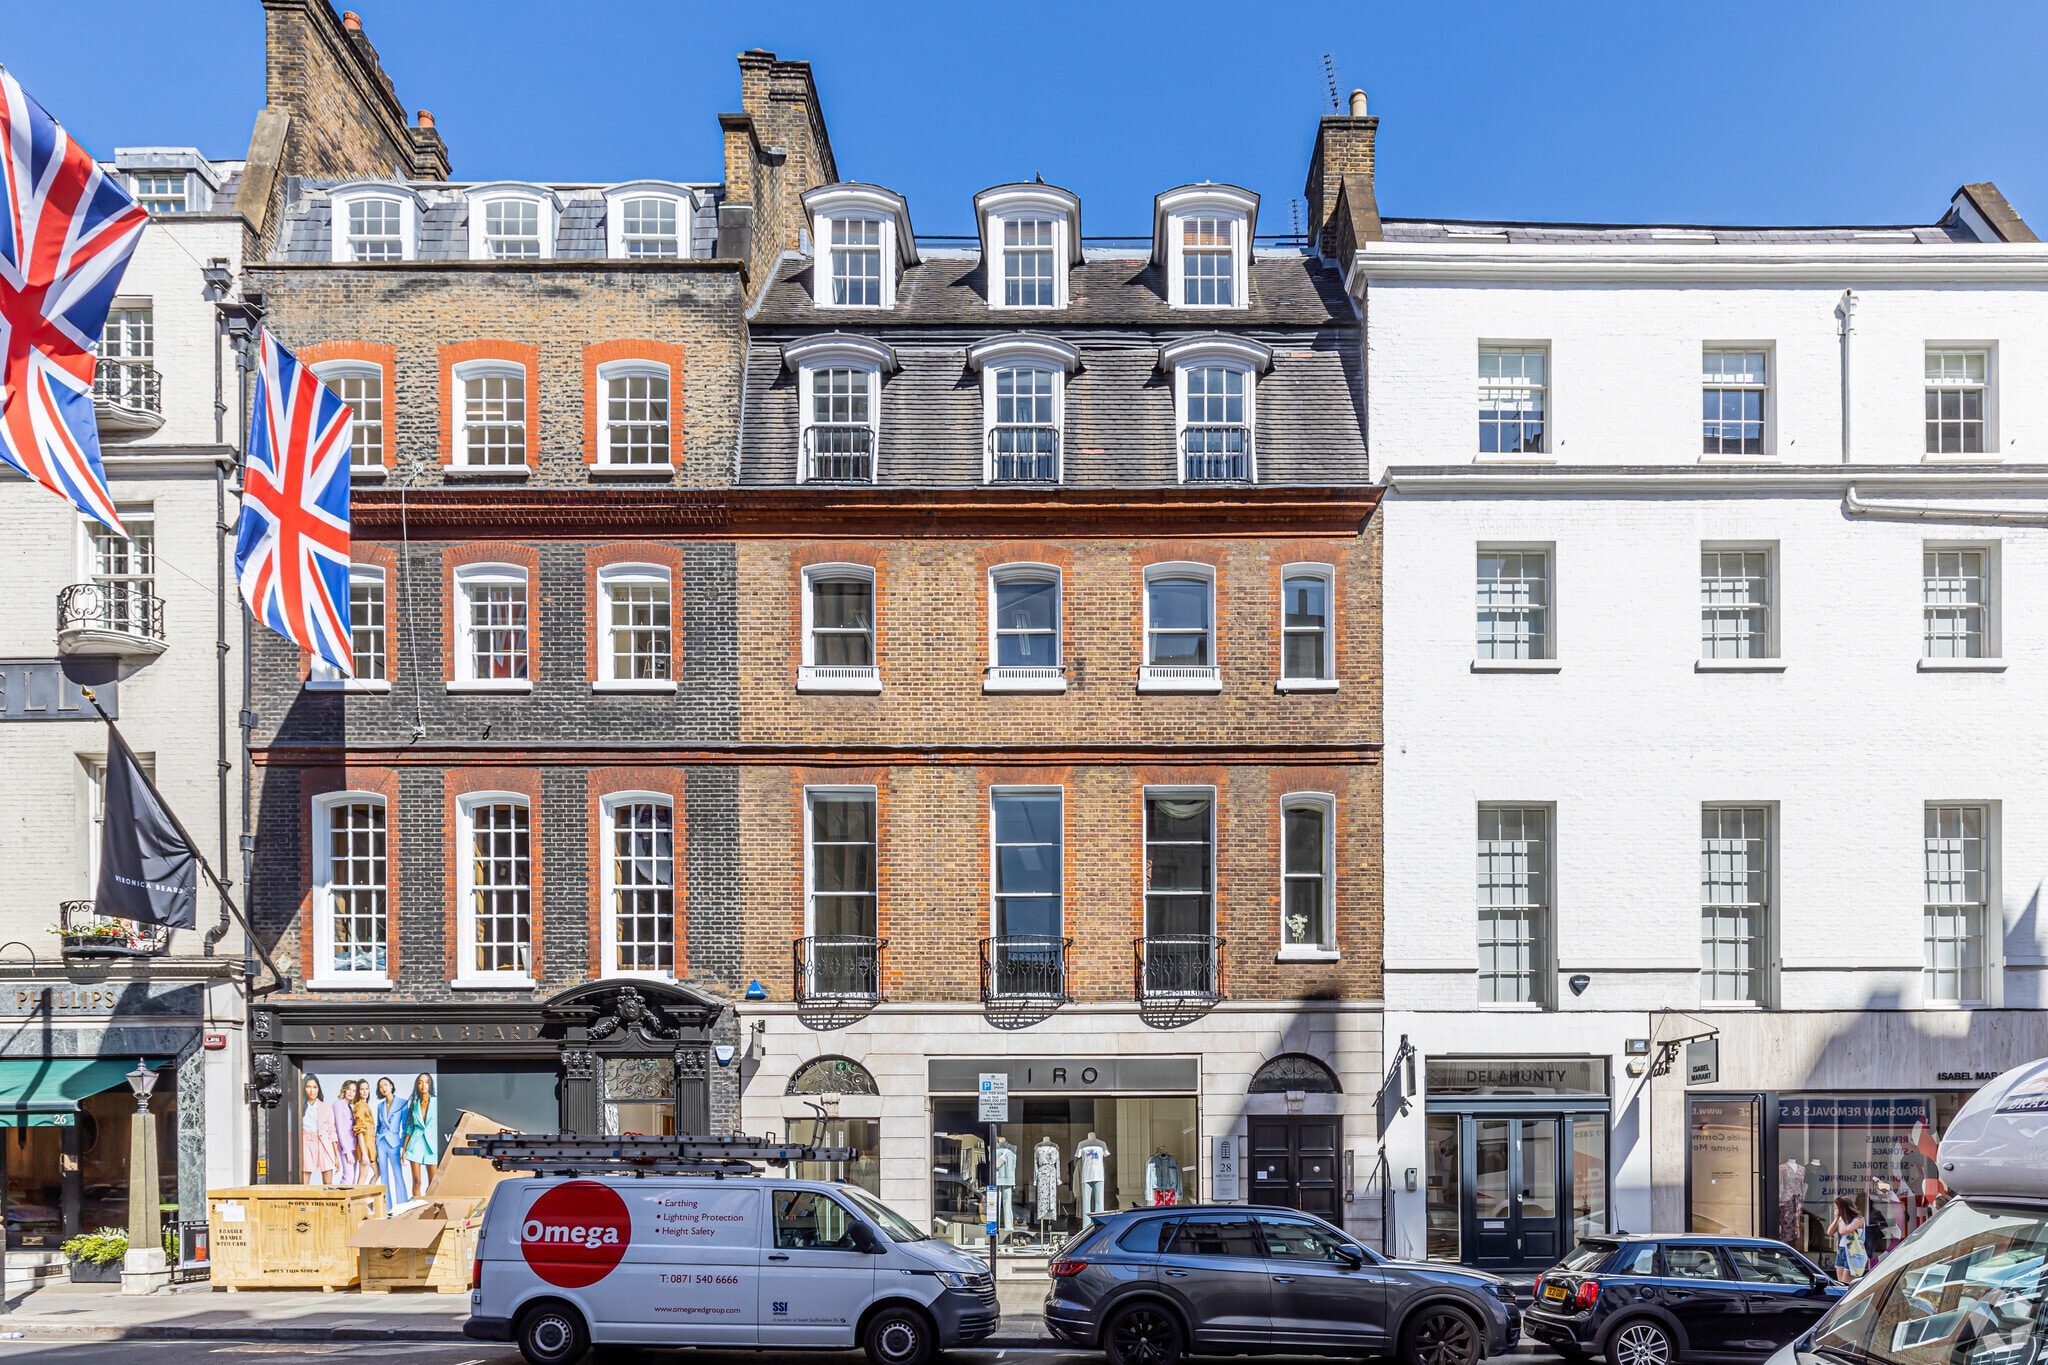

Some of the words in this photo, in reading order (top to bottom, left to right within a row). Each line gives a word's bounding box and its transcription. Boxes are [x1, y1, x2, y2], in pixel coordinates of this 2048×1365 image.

[115, 875, 151, 889] VERONICA
[155, 885, 183, 894] BEARD
[17, 991, 116, 1009] PHILLIPS
[308, 1025, 443, 1041] VERONICA
[460, 1025, 540, 1041] BEARD
[1466, 1070, 1567, 1083] DELAHUNTY
[1691, 1072, 1712, 1081] MARANT
[1938, 1072, 1973, 1081] ISABEL
[1976, 1072, 2004, 1080] MAR
[54, 1113, 67, 1125] 26
[1220, 1163, 1232, 1172] 28
[664, 1199, 698, 1209] Earthing
[663, 1213, 699, 1223] Lightning
[701, 1213, 744, 1222] Protection
[521, 1219, 619, 1249] Omega
[662, 1227, 689, 1236] Height
[690, 1227, 715, 1237] Safety
[670, 1274, 692, 1284] 0871
[695, 1275, 713, 1284] 540
[715, 1275, 739, 1284] 6666
[654, 1305, 741, 1315] www.omegaredgroup.com
[773, 1301, 788, 1312] SSI
